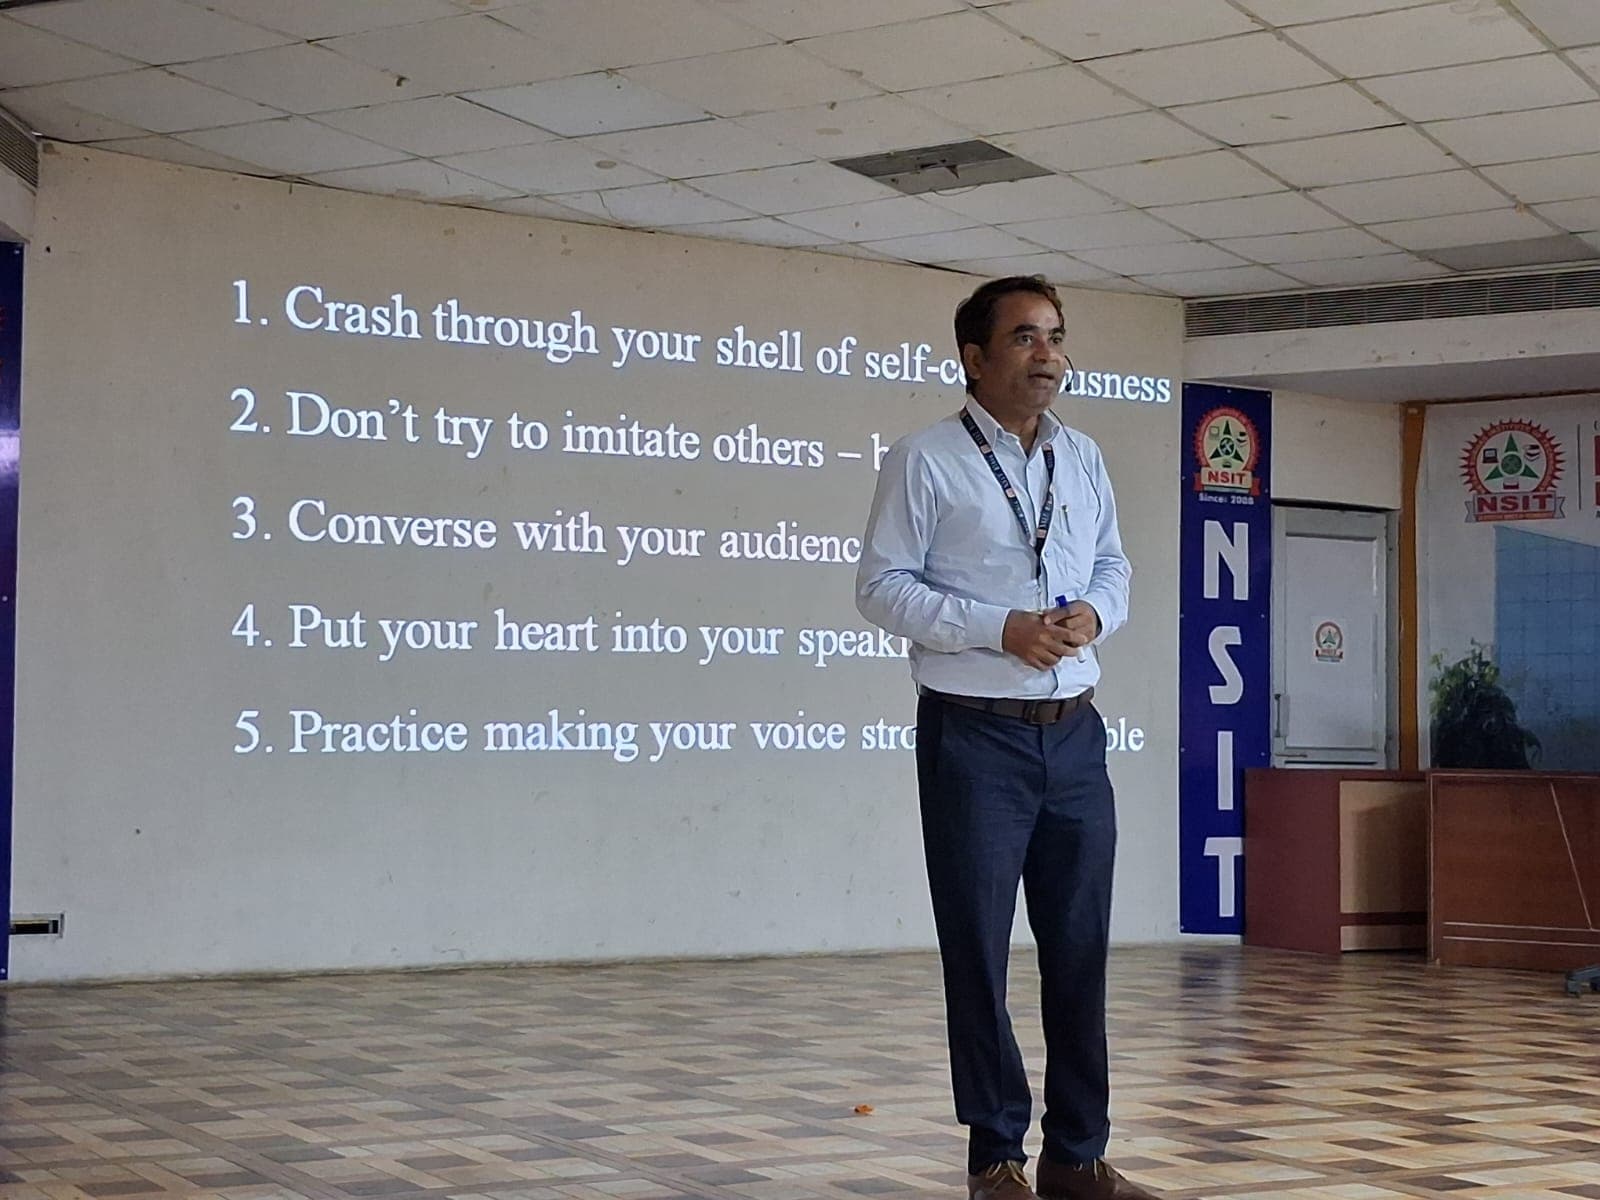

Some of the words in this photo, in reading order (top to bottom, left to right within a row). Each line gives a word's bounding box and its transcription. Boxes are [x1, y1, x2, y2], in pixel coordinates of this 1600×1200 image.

[233, 280, 268, 325] 1.
[285, 286, 422, 339] Crash
[432, 299, 600, 364] through
[611, 327, 702, 368] your
[716, 326, 803, 373] shell
[816, 337, 857, 377] of
[230, 388, 271, 433] 2.
[434, 407, 493, 459] try
[507, 412, 548, 450] to
[562, 410, 700, 460] imitate
[712, 424, 825, 468] others
[1208, 470, 1247, 485] NSIT
[1477, 494, 1554, 513] NSIT
[232, 496, 272, 541] 3.
[288, 499, 497, 550] Converse
[513, 510, 607, 553] with
[616, 526, 706, 567] your
[720, 521, 863, 564] audienc
[232, 603, 273, 647] 4.
[288, 604, 367, 648] Put
[378, 620, 478, 662] your
[494, 608, 599, 652] heart
[611, 611, 688, 653] into
[699, 626, 785, 666] your
[234, 710, 273, 754] 5.
[289, 709, 468, 753] Practice
[484, 709, 639, 763] making
[649, 722, 737, 763] your
[750, 711, 846, 751] voice
[862, 716, 918, 752] stro
